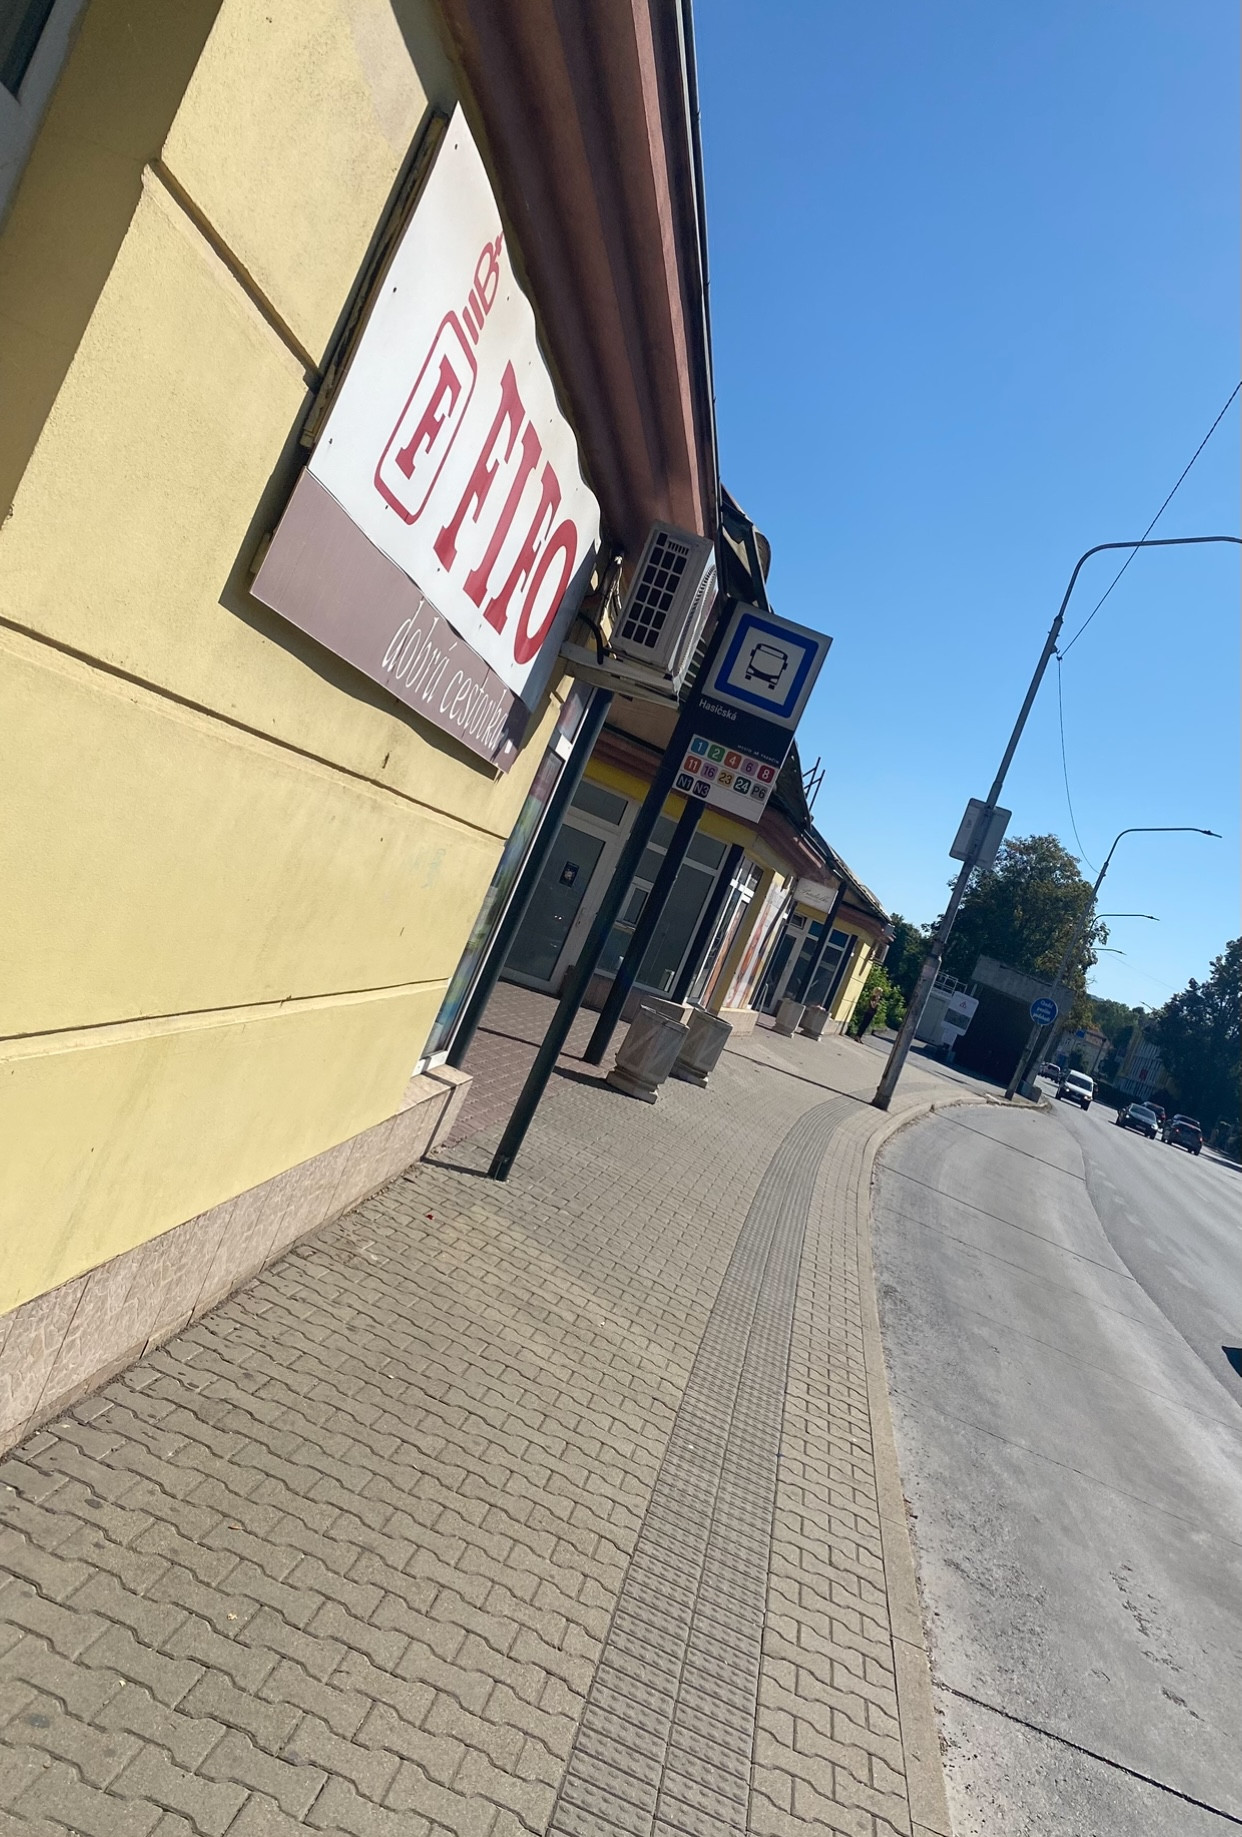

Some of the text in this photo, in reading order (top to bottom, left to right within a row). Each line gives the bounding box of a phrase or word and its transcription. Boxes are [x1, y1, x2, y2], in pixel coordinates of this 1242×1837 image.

[433, 360, 577, 664] FIFO
[382, 600, 458, 703] dobrá
[699, 698, 737, 721] Hasičská
[688, 760, 766, 799] 11 16 23 24 P6
[712, 749, 721, 760] 2
[729, 756, 737, 767] 4
[745, 762, 753, 773] 6
[762, 768, 771, 780] 8
[678, 776, 709, 796] N1 N3
